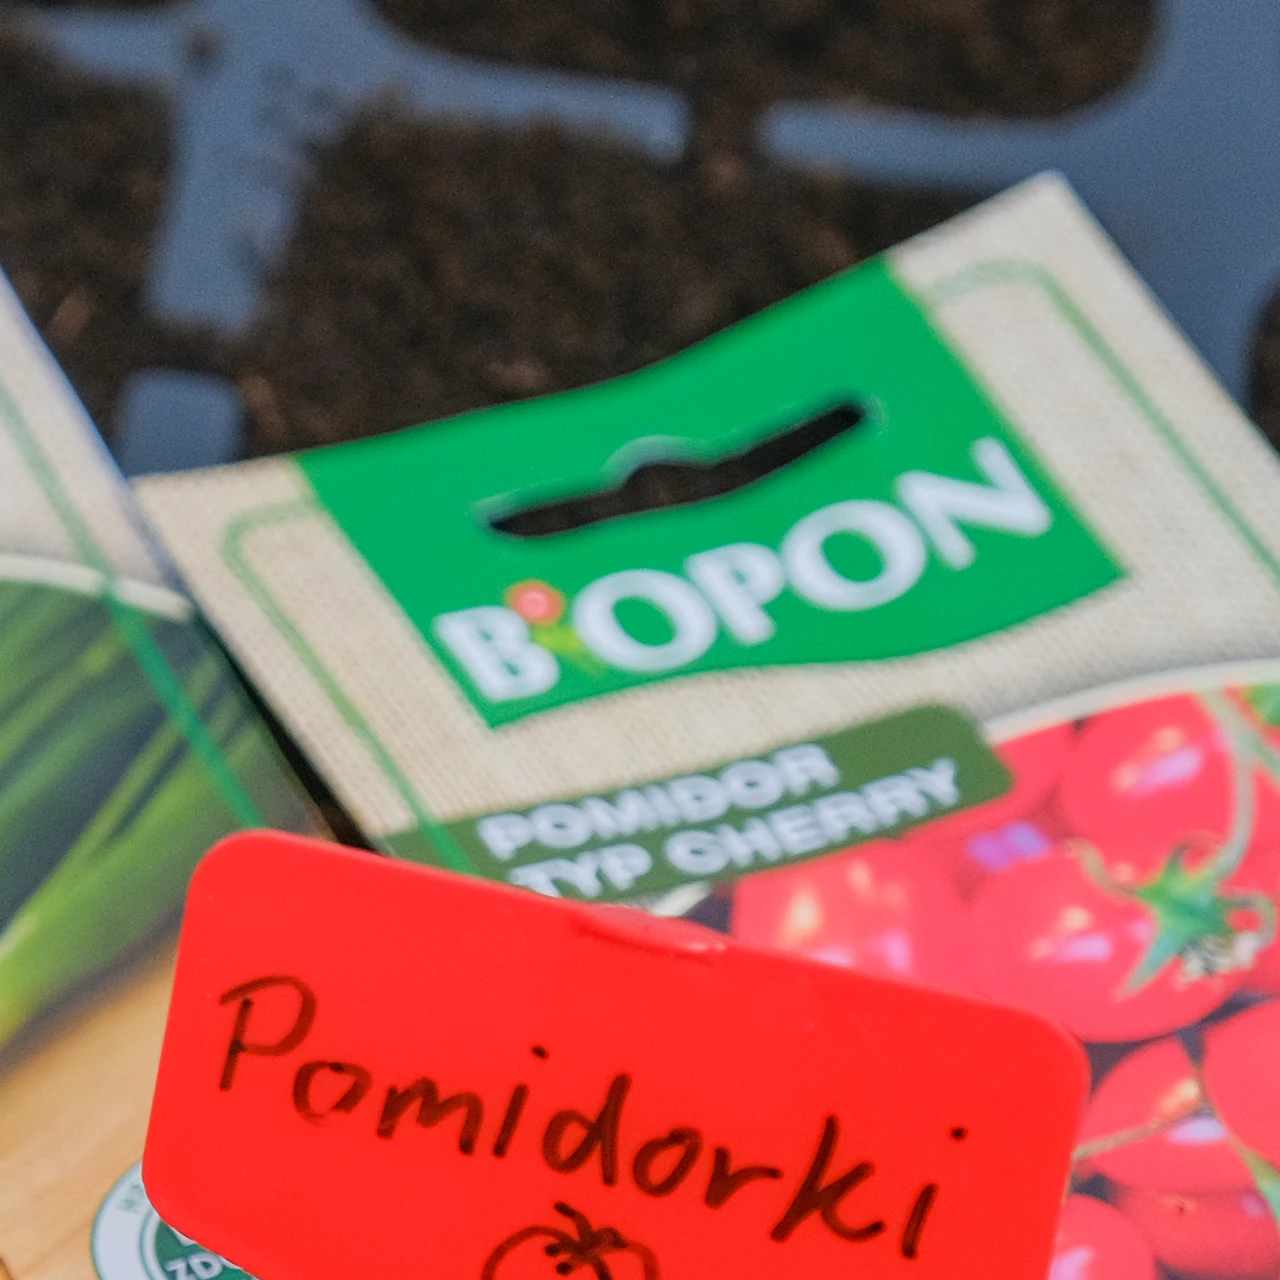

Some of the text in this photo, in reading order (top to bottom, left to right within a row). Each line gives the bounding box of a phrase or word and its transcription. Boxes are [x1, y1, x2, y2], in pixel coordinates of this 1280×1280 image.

[432, 436, 1052, 701] BIOPON
[477, 742, 840, 861] POMIDOR
[508, 757, 958, 898] TYP CHERRY
[219, 974, 966, 1260] Pomidorki
